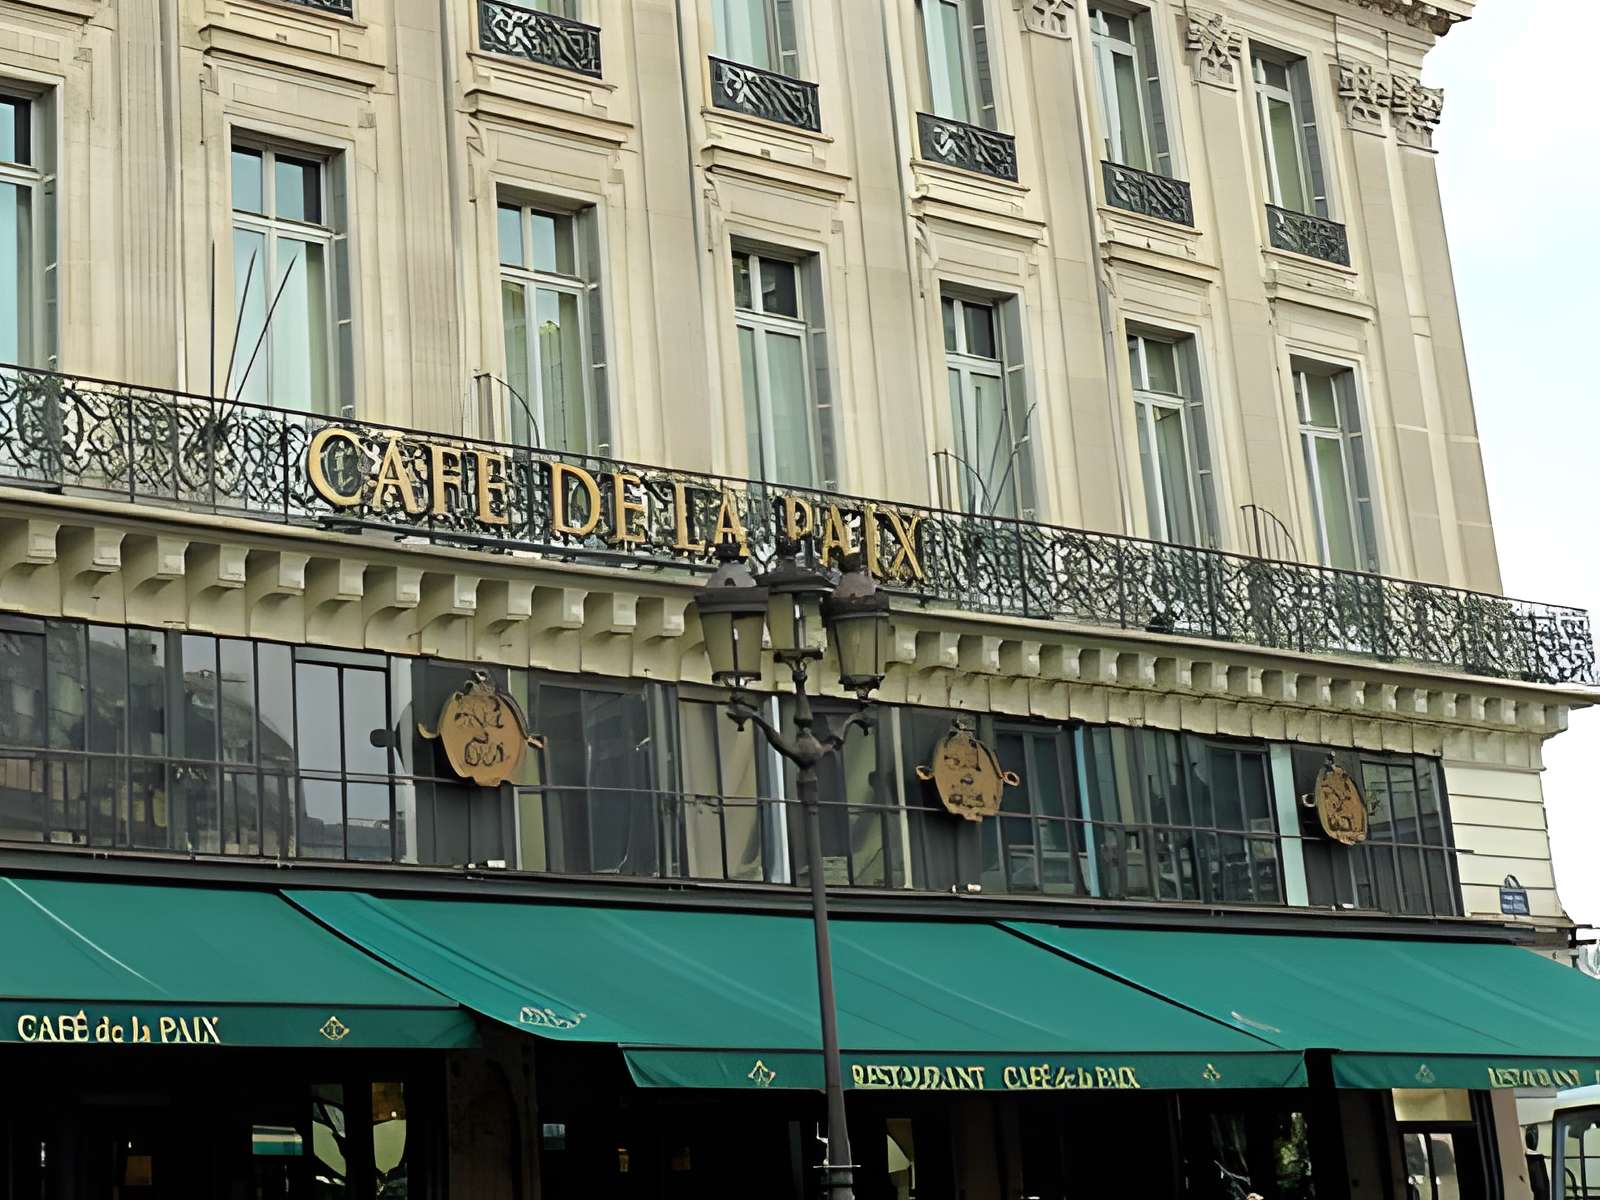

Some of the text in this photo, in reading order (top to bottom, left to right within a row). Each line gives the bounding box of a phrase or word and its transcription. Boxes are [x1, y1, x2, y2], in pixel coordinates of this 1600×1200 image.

[551, 461, 647, 545] DE
[672, 477, 750, 558] LA
[783, 494, 925, 580] PAIX
[159, 1015, 221, 1044] PAIX
